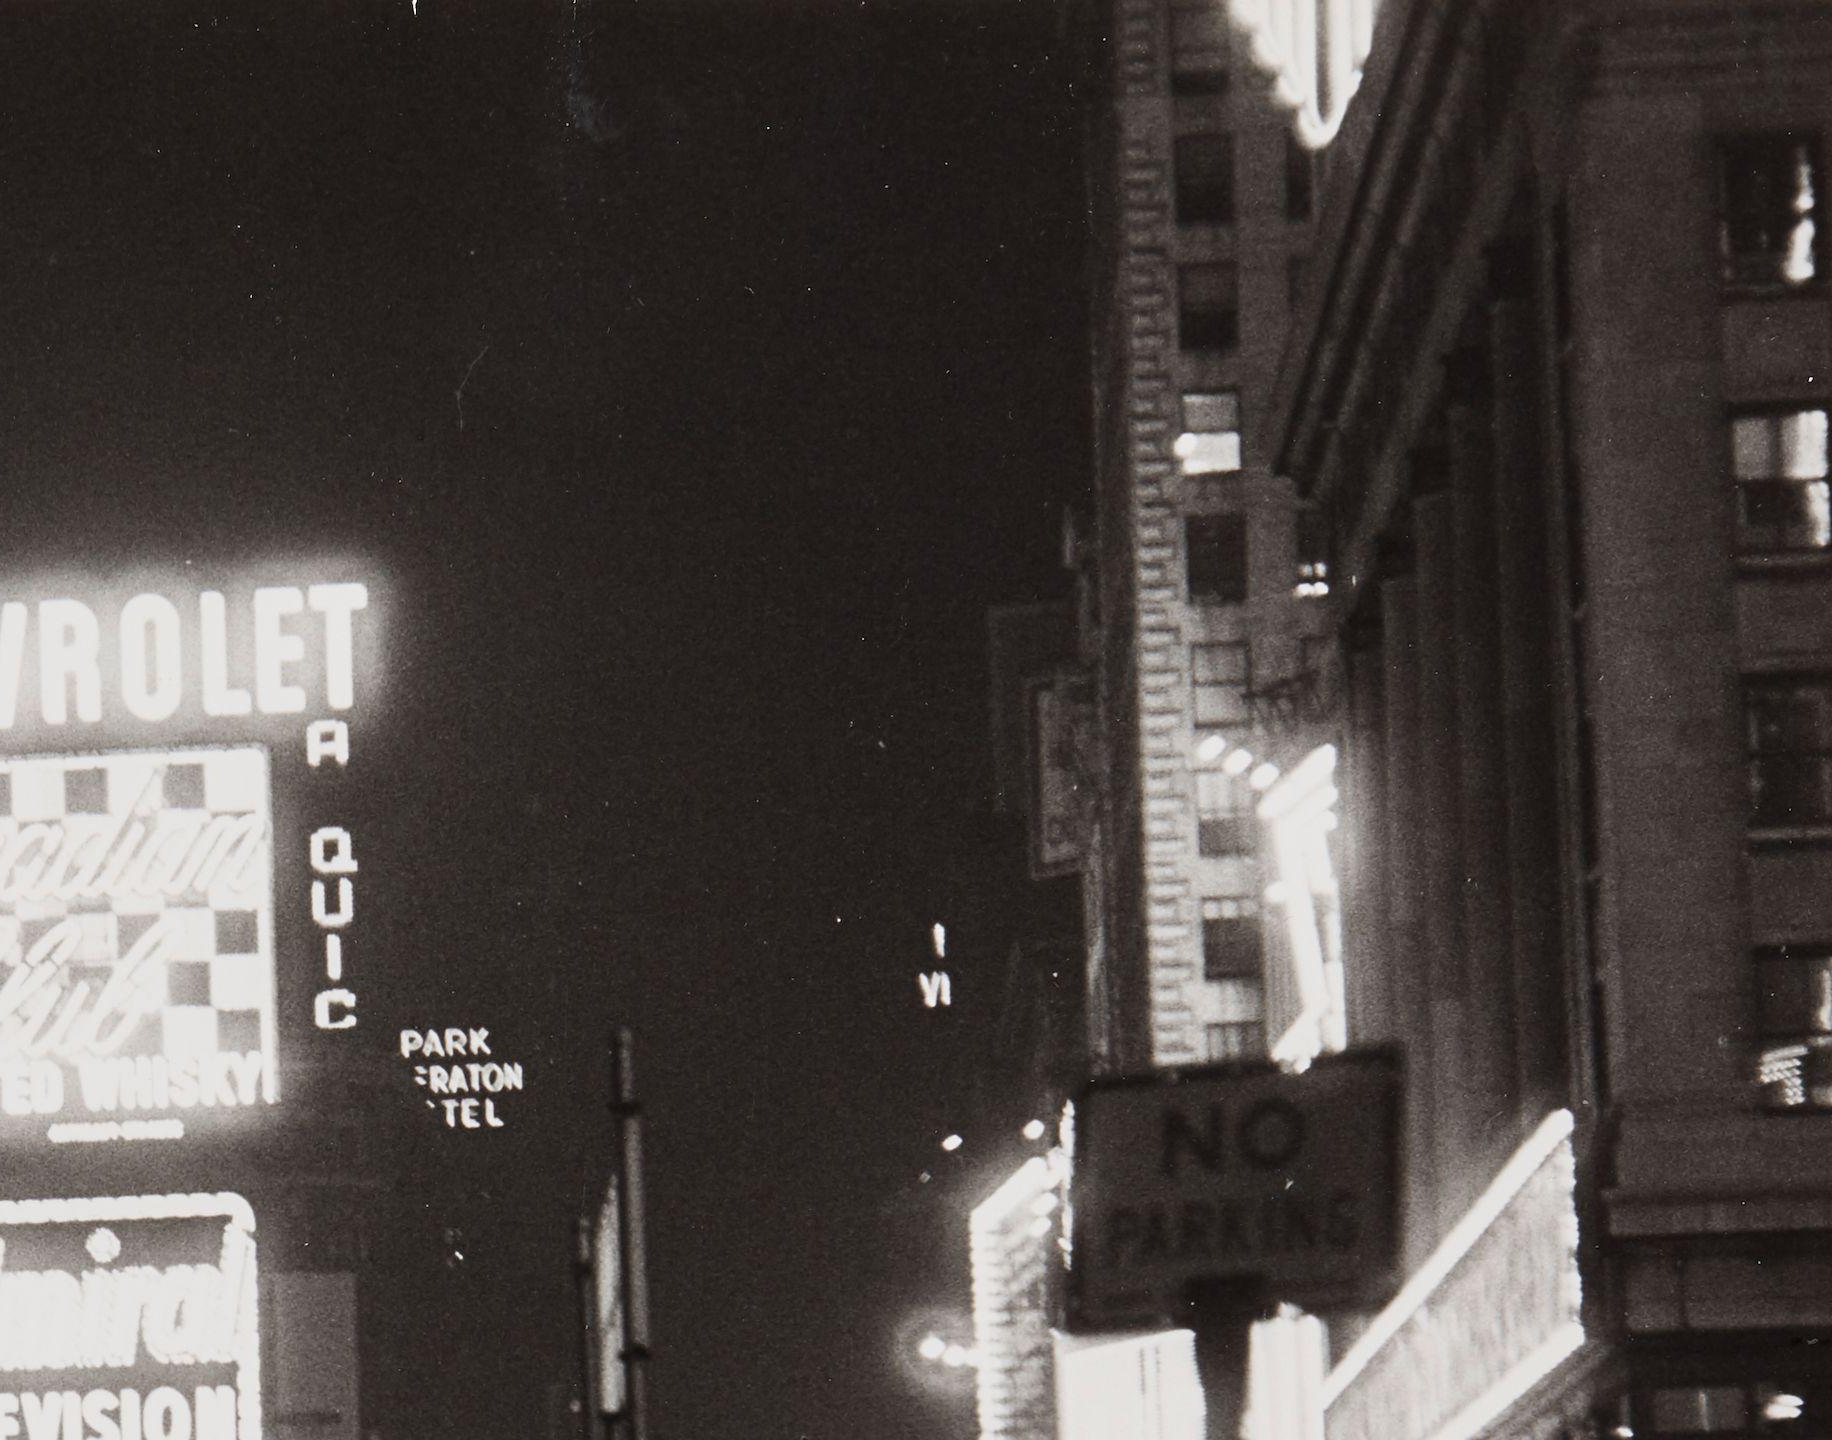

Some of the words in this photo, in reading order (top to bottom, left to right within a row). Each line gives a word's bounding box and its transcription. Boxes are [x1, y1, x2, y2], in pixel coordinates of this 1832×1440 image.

[307, 717, 349, 767] A
[310, 826, 358, 1029] QUIC
[400, 1027, 492, 1059] PARK
[75, 1052, 265, 1111] WHISKY
[426, 1098, 504, 1129] TEL
[1163, 1097, 1308, 1178] NO
[1104, 1190, 1360, 1268] PARKING
